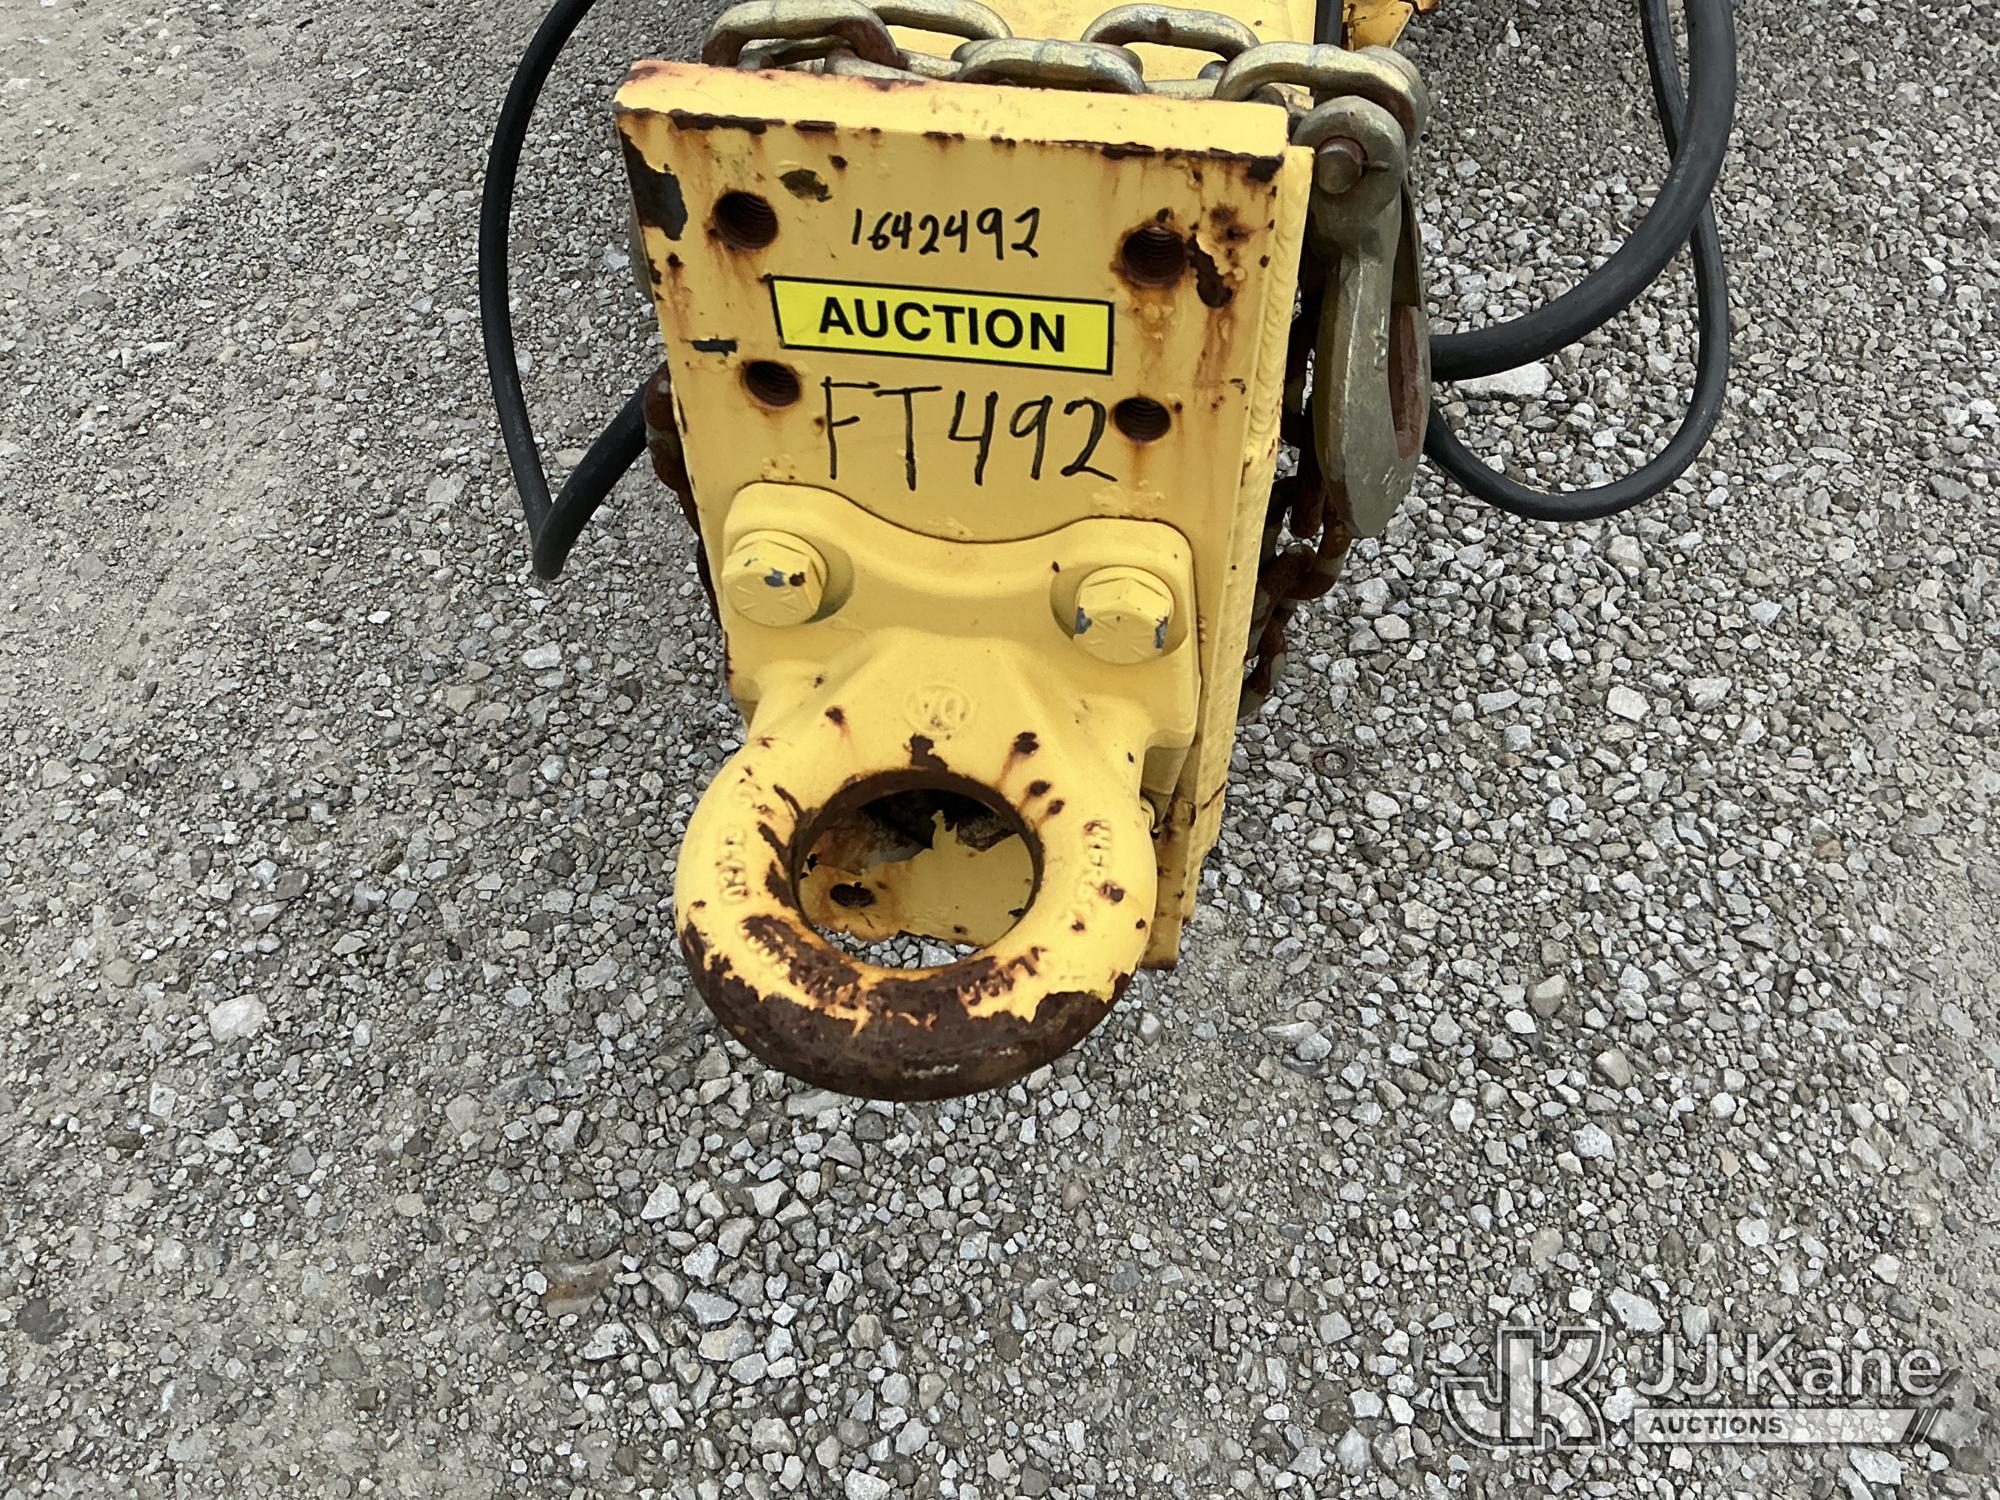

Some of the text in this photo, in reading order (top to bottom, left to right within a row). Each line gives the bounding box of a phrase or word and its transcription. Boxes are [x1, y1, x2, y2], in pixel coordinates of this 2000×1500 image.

[852, 207, 1040, 260] 1642492
[818, 296, 1066, 352] AUCTION
[820, 375, 1118, 490] FT492
